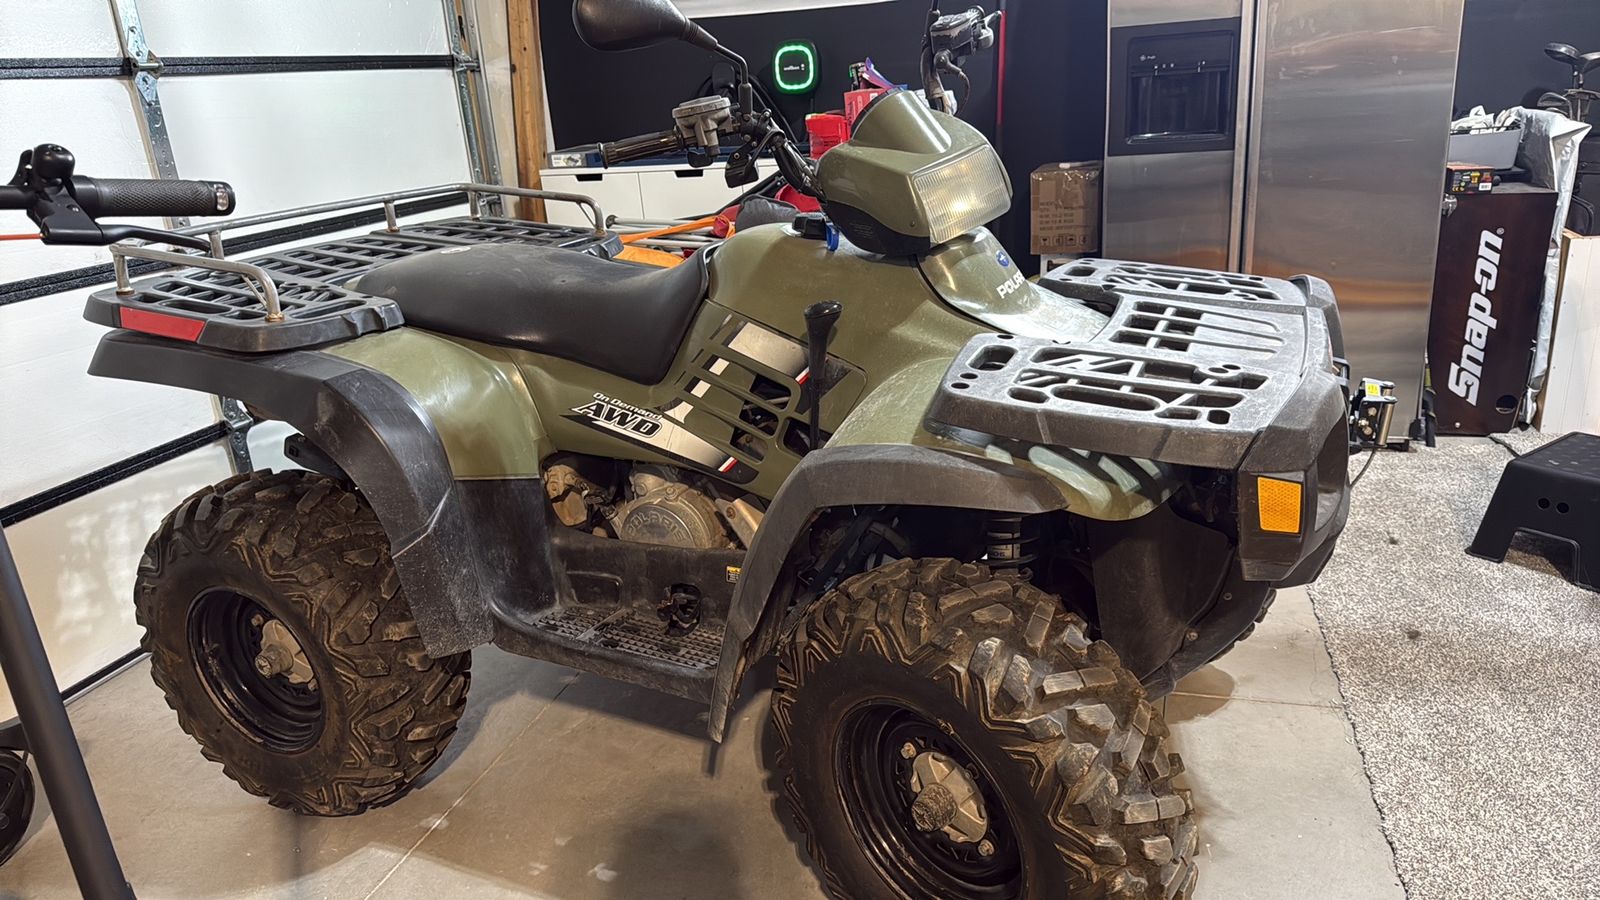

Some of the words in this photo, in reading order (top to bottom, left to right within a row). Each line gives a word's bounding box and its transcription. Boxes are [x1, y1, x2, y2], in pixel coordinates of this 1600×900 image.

[1448, 229, 1503, 406] Snap-on
[571, 400, 662, 438] AWD
[593, 392, 609, 402] On
[610, 398, 662, 420] Demand
